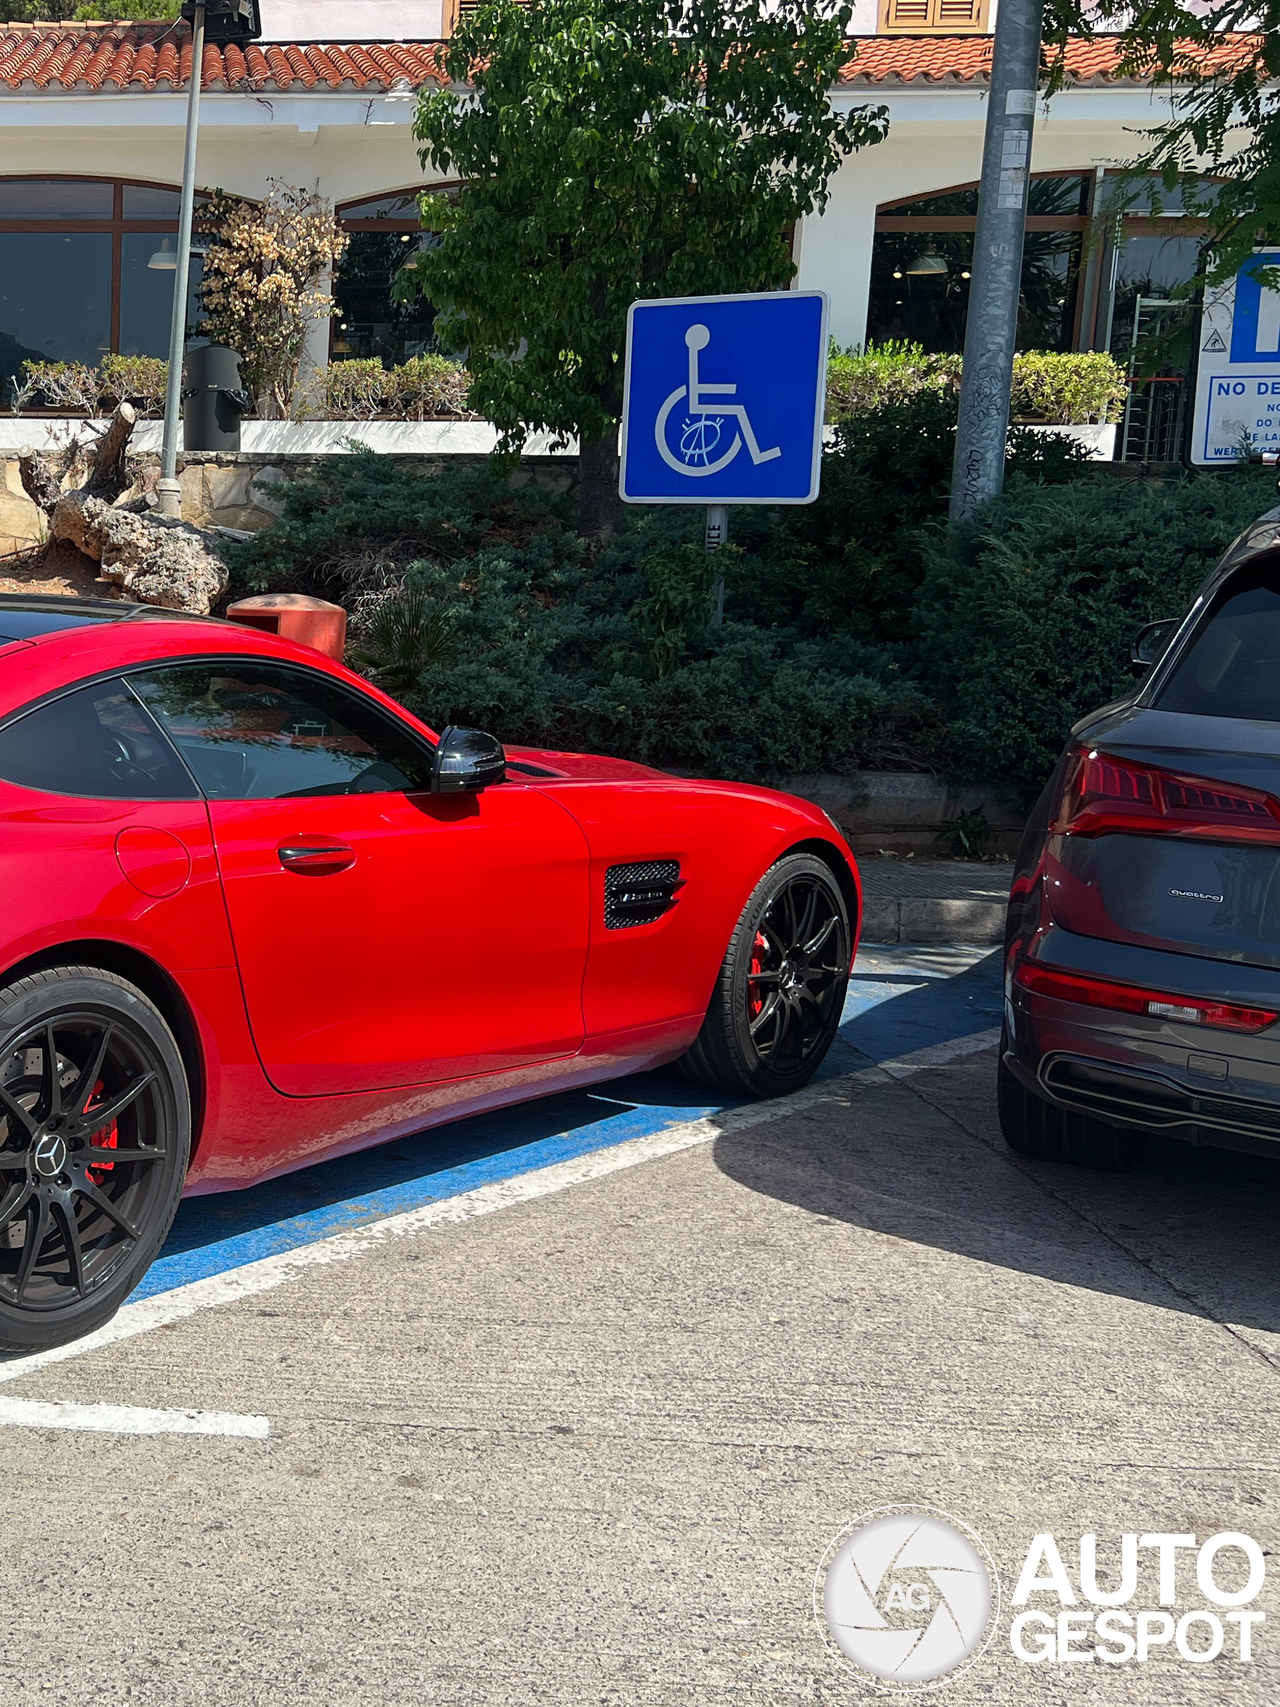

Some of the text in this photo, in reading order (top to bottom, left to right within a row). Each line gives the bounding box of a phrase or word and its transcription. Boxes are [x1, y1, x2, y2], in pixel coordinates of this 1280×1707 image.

[1217, 382, 1246, 396] NO
[1256, 418, 1272, 427] DO
[1265, 433, 1280, 441] LA
[1171, 889, 1220, 901] quattro
